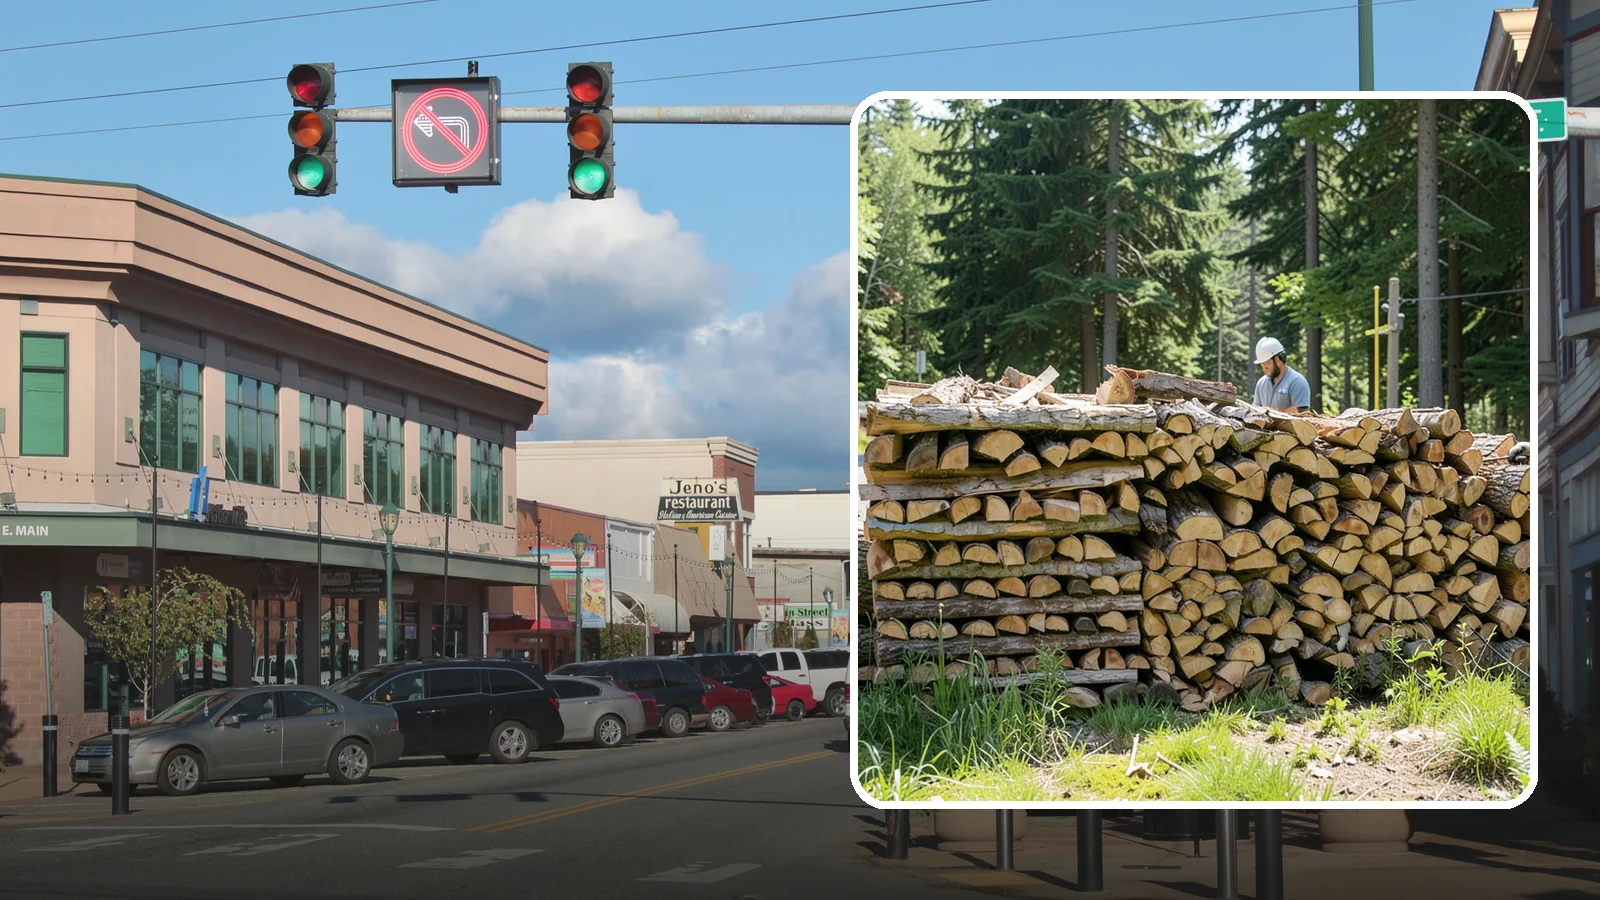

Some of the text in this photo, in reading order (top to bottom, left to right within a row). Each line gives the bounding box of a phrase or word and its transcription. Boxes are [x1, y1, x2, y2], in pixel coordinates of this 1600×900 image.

[669, 480, 727, 494] Jeno's
[665, 496, 731, 509] restaurant
[658, 510, 681, 519] Italian
[686, 510, 714, 519] American
[714, 510, 737, 519] Cuisine
[2, 525, 49, 536] E. MAIN
[785, 608, 795, 616] in
[797, 607, 828, 617] Street
